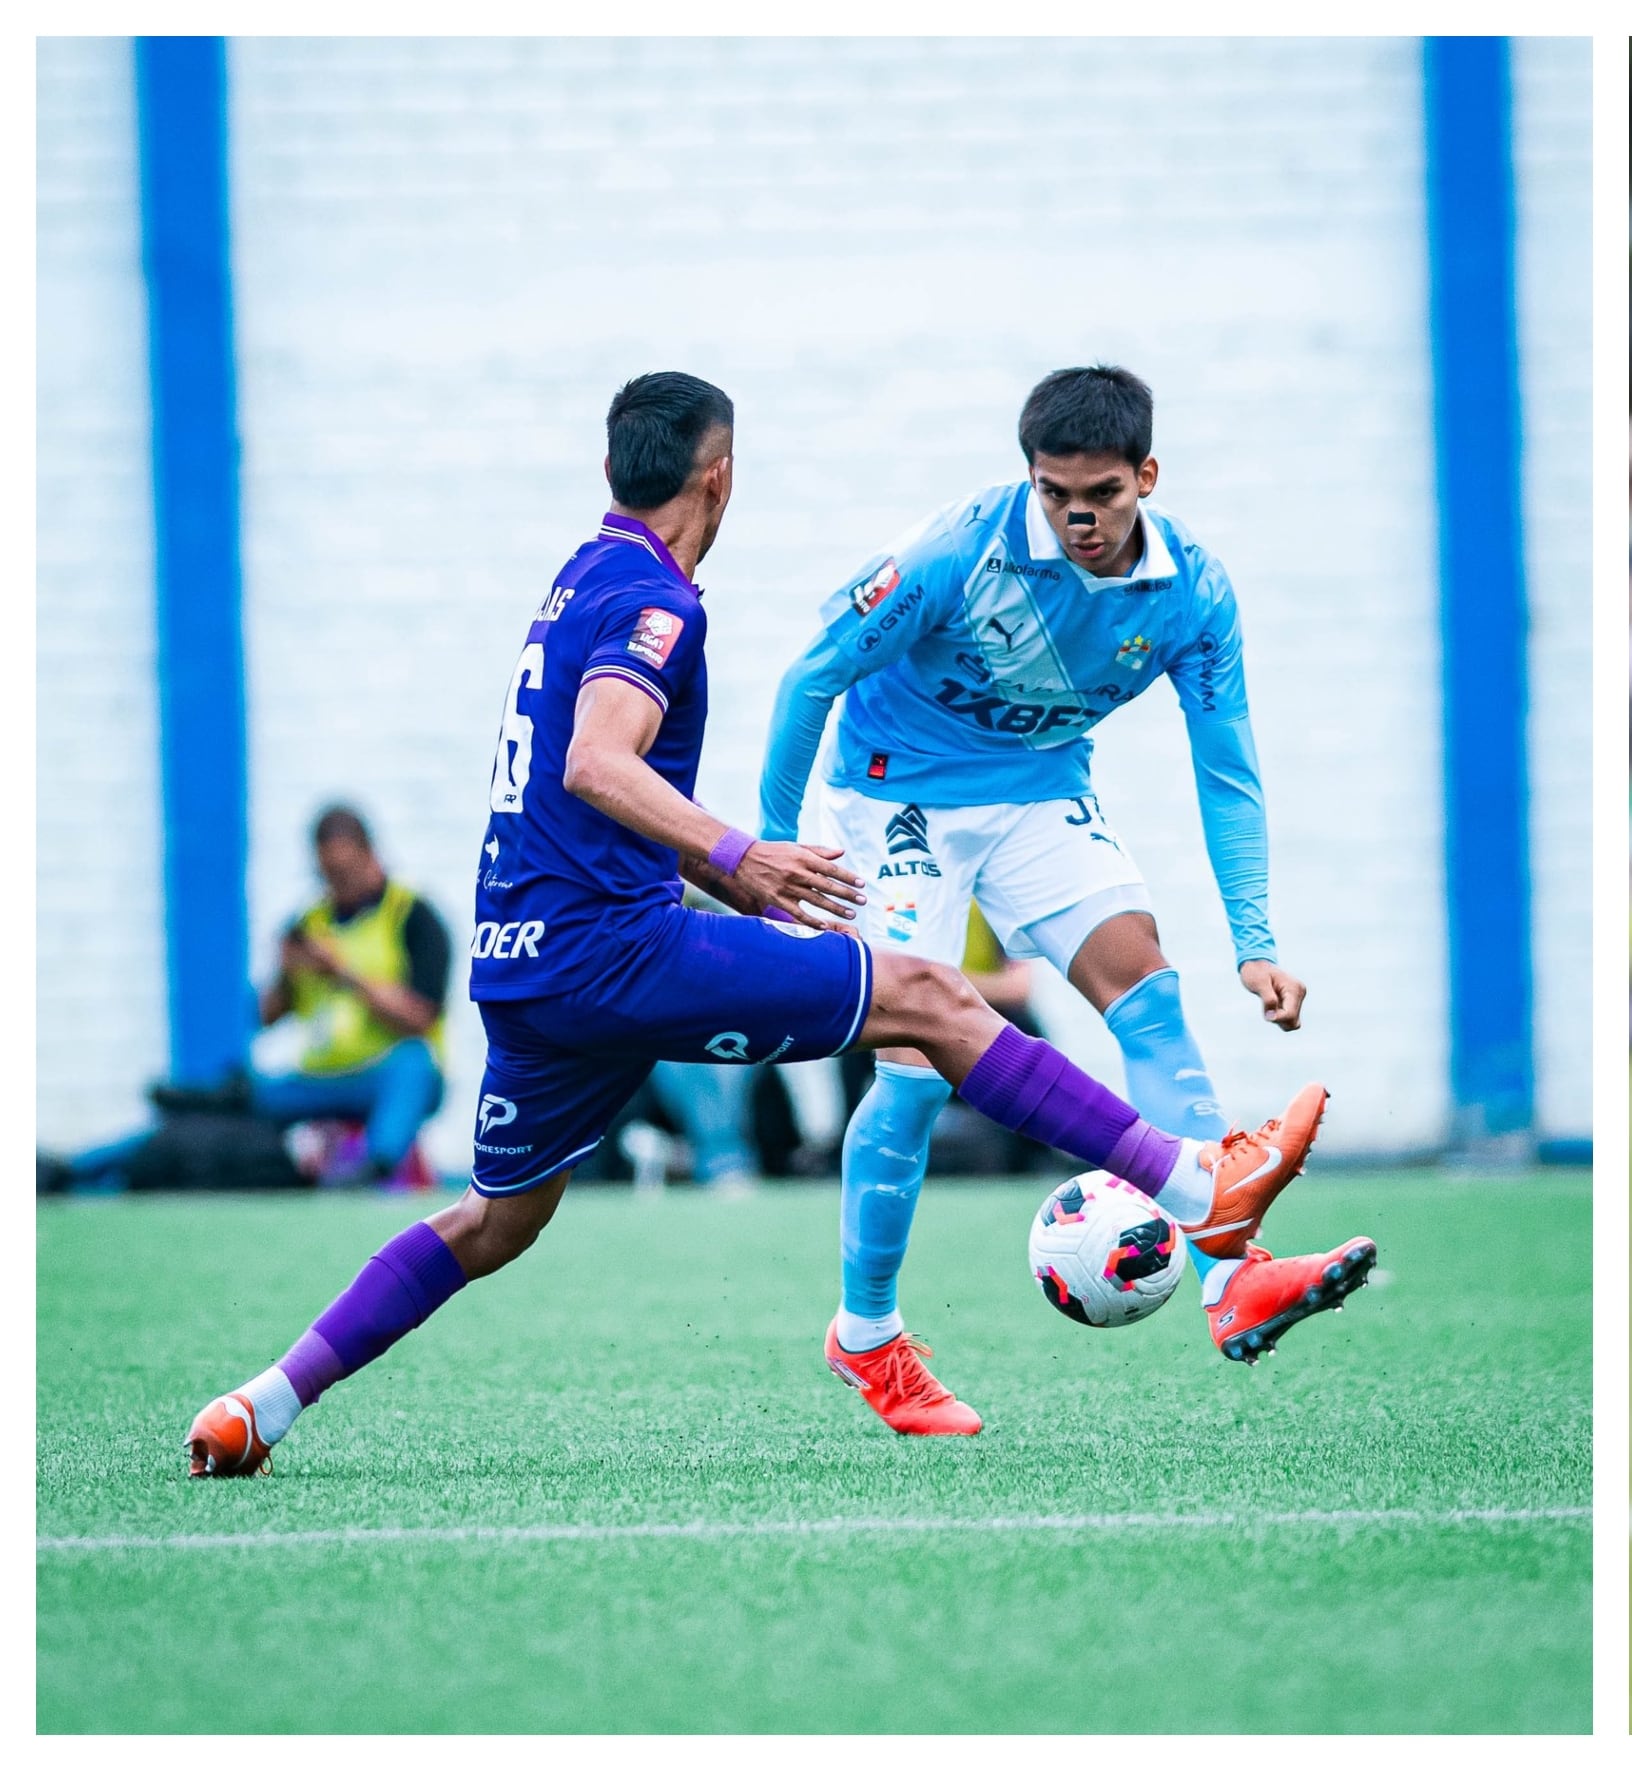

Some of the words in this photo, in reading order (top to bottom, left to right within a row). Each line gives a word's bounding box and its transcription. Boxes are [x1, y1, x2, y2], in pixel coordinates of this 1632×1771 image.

[880, 583, 926, 632] GWM
[877, 859, 943, 880] ALTOS
[470, 920, 546, 960] DER
